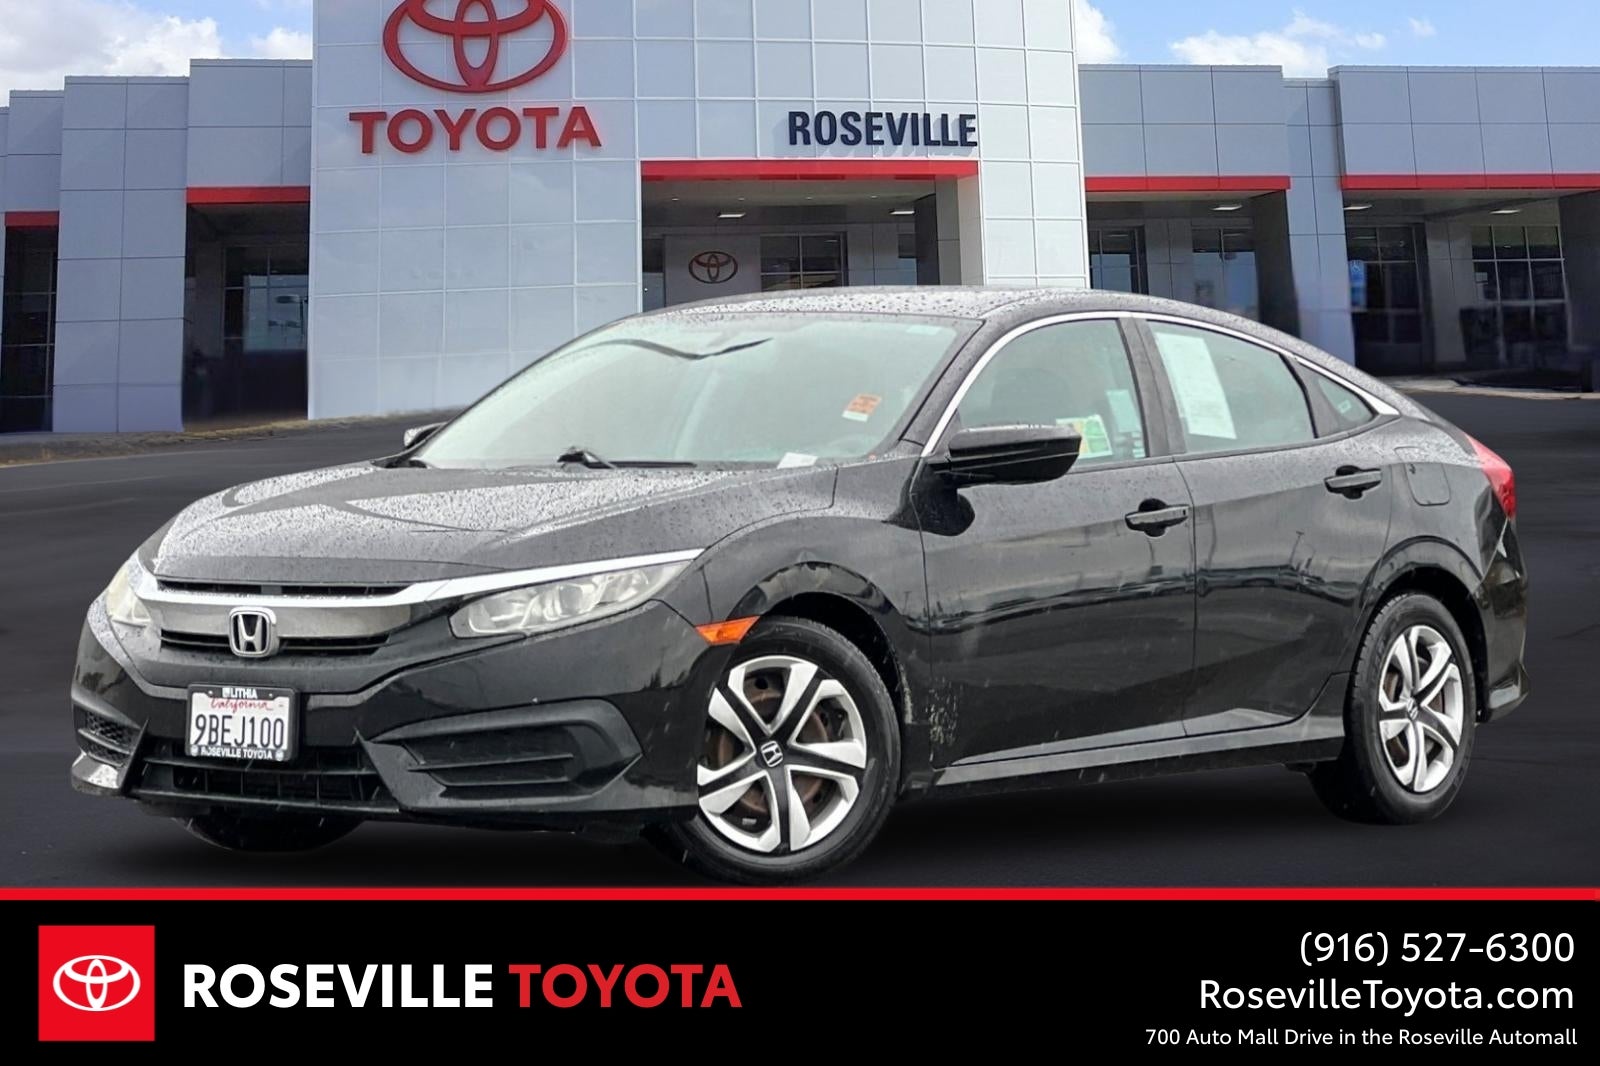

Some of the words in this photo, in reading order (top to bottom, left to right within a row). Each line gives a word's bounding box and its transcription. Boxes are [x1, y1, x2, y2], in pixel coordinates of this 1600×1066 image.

[350, 106, 601, 154] TOYOTA
[788, 110, 978, 147] ROSEVILLE
[210, 697, 273, 713] California
[231, 687, 258, 699] LITHIA
[194, 713, 284, 749] 9BEJ100
[201, 746, 241, 758] ROSEVILLE
[243, 748, 273, 760] TOYOTA
